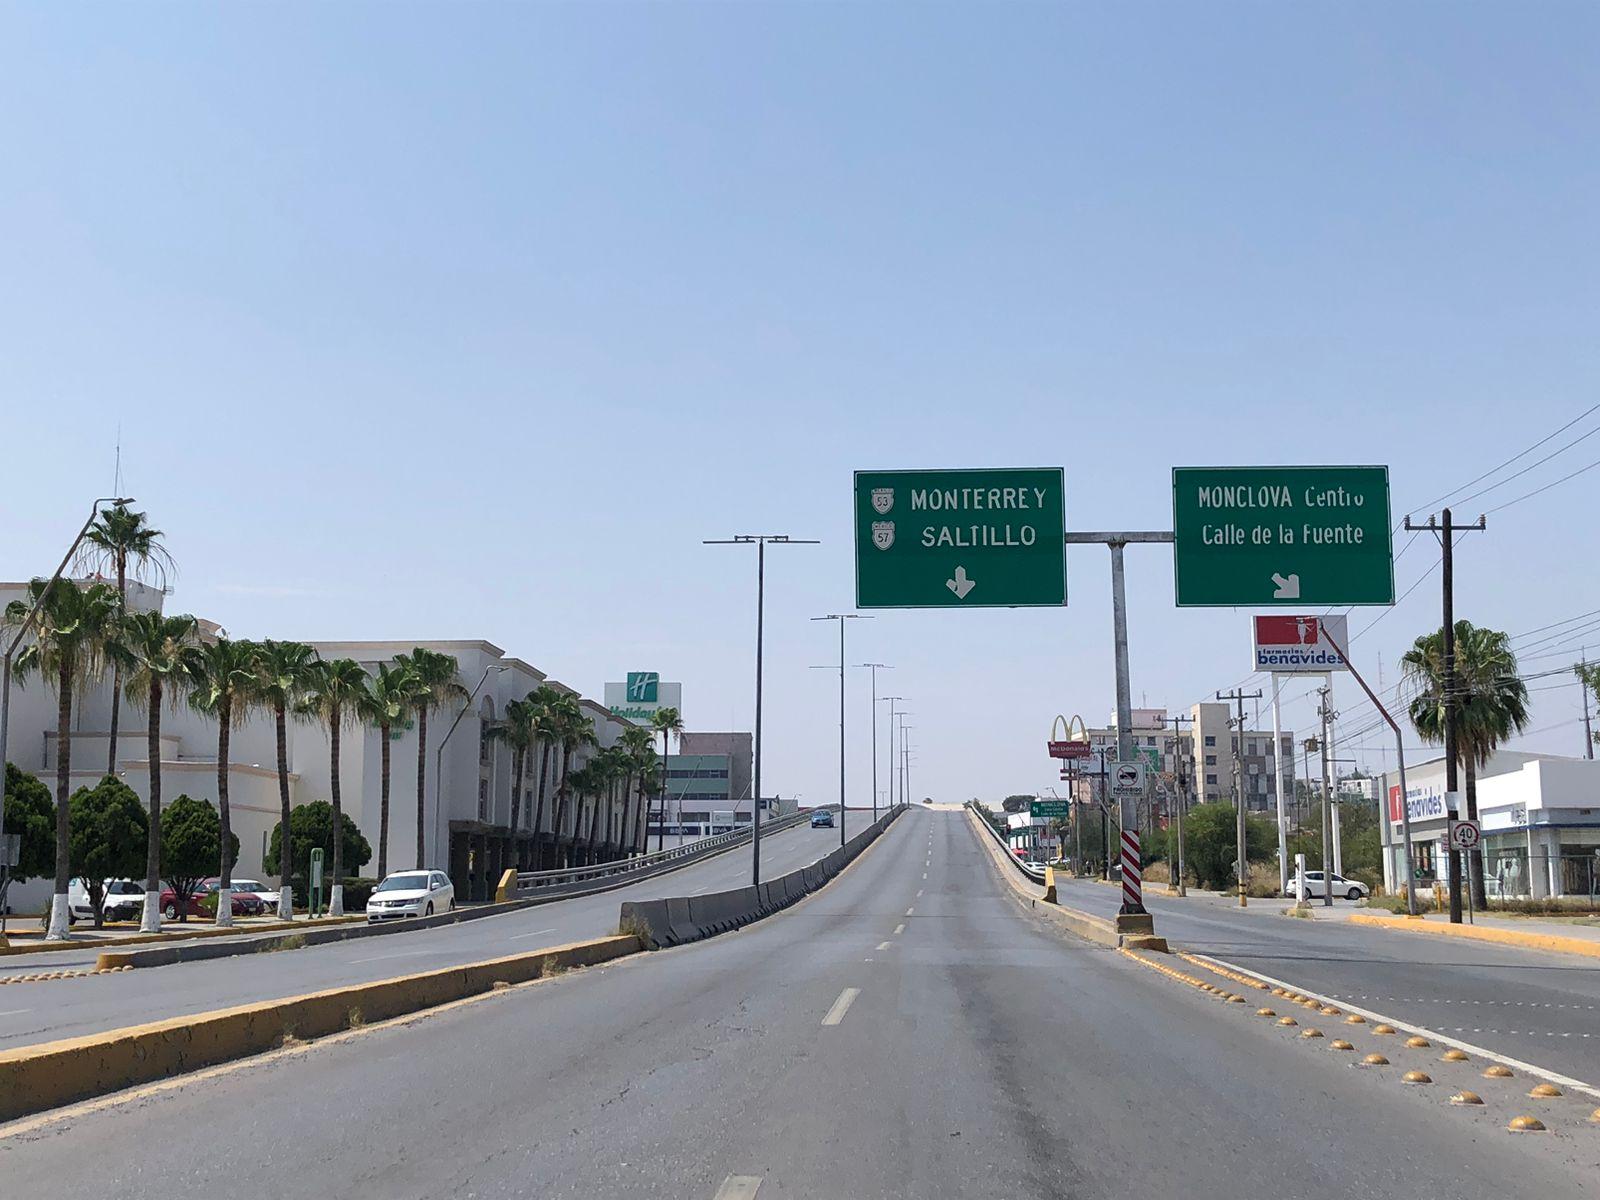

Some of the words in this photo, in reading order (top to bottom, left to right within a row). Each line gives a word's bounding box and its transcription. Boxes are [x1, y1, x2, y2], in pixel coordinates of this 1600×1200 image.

[877, 496, 889, 507] 53
[911, 487, 1047, 511] MONTERREY
[1198, 485, 1293, 508] MONCLOVA
[877, 532, 889, 543] 57
[921, 524, 1036, 547] SALTILLO
[1202, 523, 1245, 545] Calle
[1251, 524, 1272, 545] de
[1278, 523, 1294, 544] la
[1303, 523, 1364, 545] Fuente
[1257, 649, 1345, 665] benavides
[1407, 786, 1443, 819] enavides
[1459, 827, 1473, 839] 40
